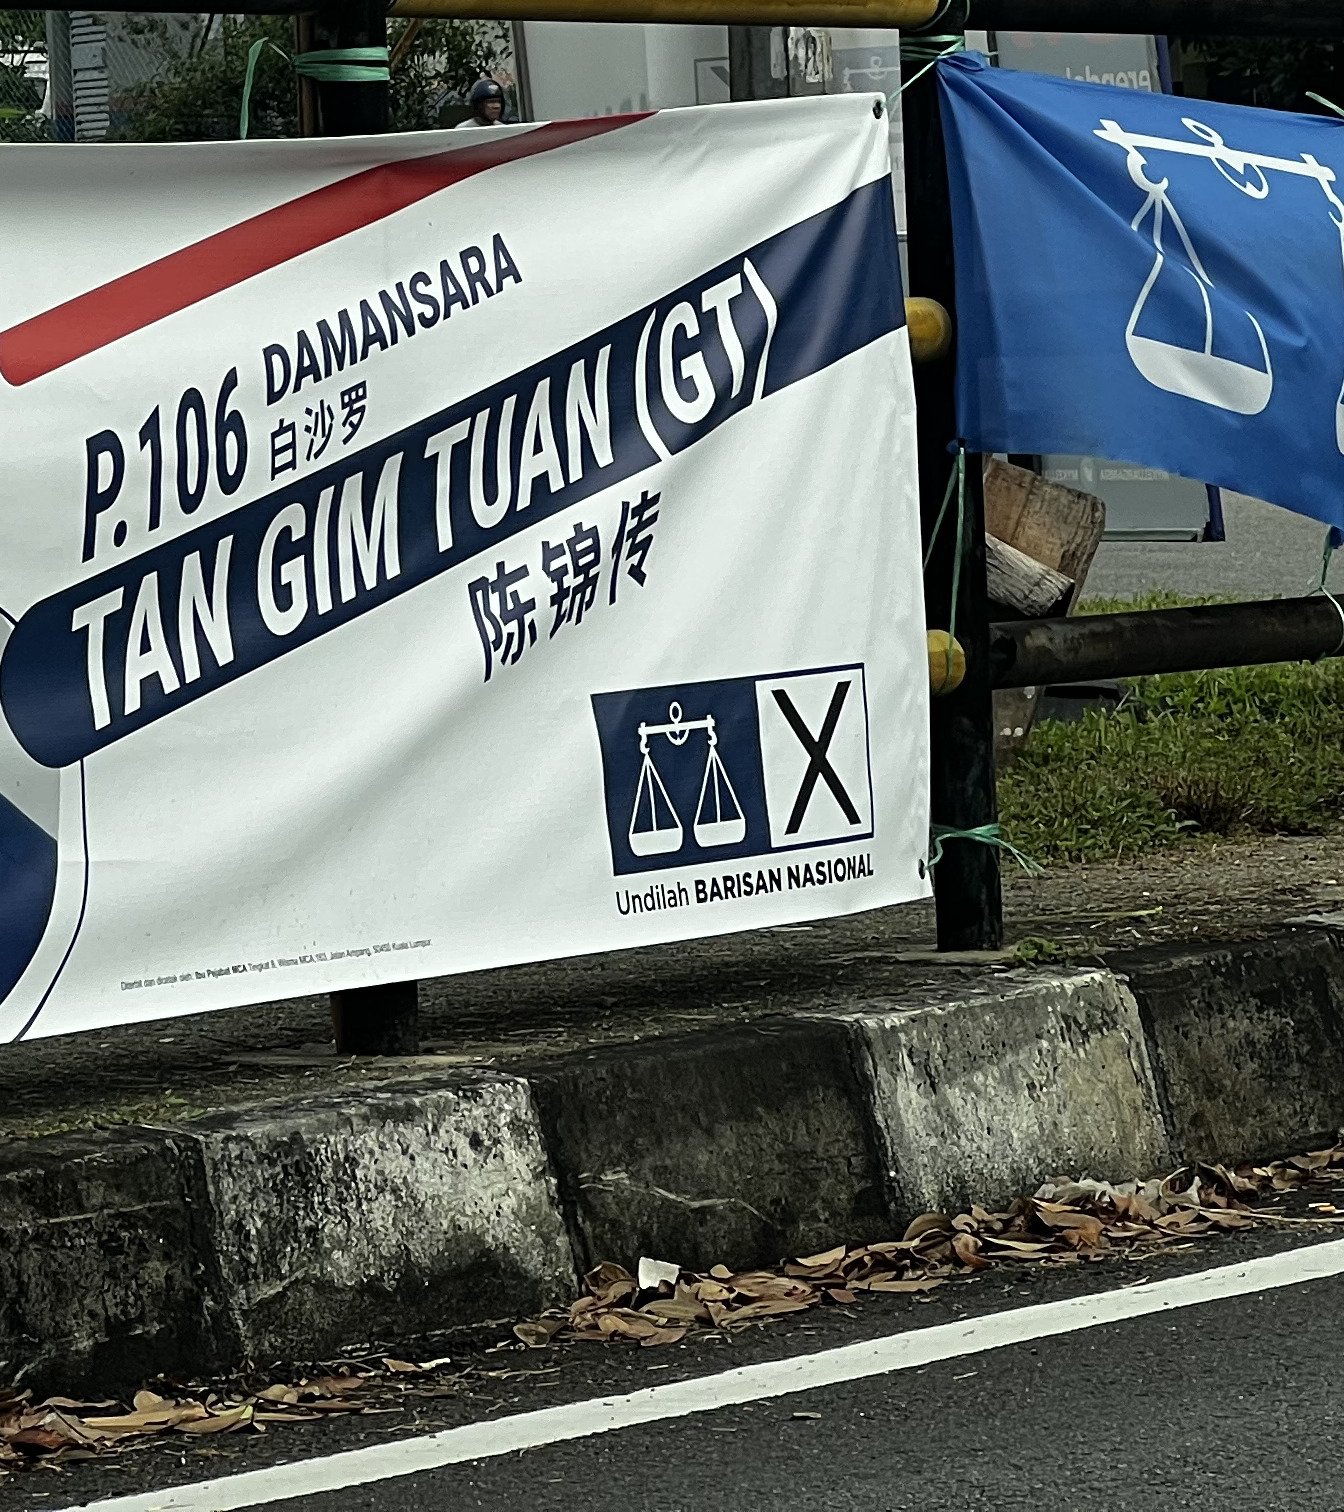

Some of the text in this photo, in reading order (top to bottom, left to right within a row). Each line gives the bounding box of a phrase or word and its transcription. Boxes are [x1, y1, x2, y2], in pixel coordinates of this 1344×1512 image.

[262, 233, 522, 406] DAMANSARA
[72, 257, 778, 731] TAN GIM TUAN (GT)
[81, 366, 247, 563] P.106
[271, 380, 367, 481] 白沙罗
[468, 490, 661, 683] 陈锦传
[616, 853, 874, 916] Undilah BARISAN NASIONAL
